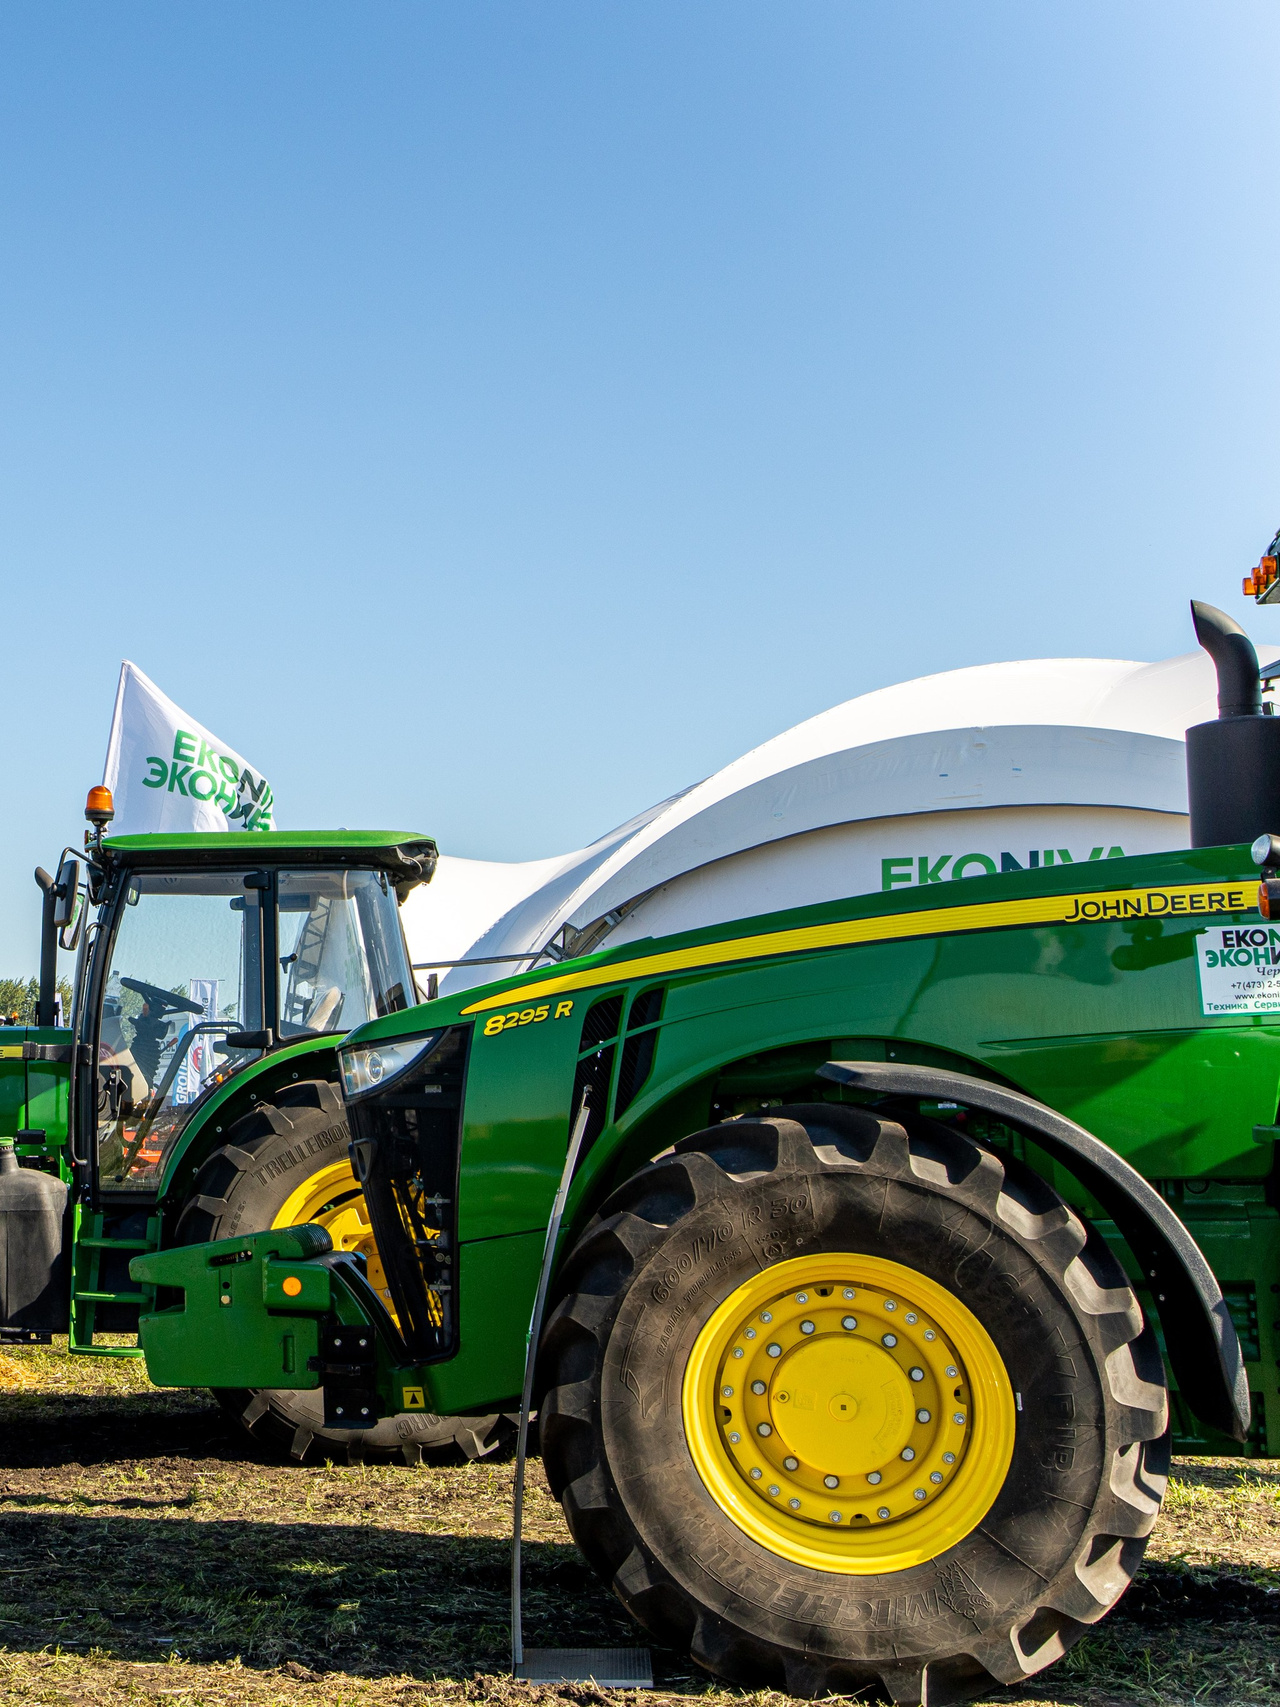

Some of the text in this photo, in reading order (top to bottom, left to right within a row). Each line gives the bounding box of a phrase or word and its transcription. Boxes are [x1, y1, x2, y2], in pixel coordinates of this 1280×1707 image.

[1065, 891, 1245, 921] JOHN DEERE
[483, 1000, 574, 1036] 8295 R
[1206, 1002, 1248, 1011] Техника
[692, 1545, 942, 1627] MICHELIN
